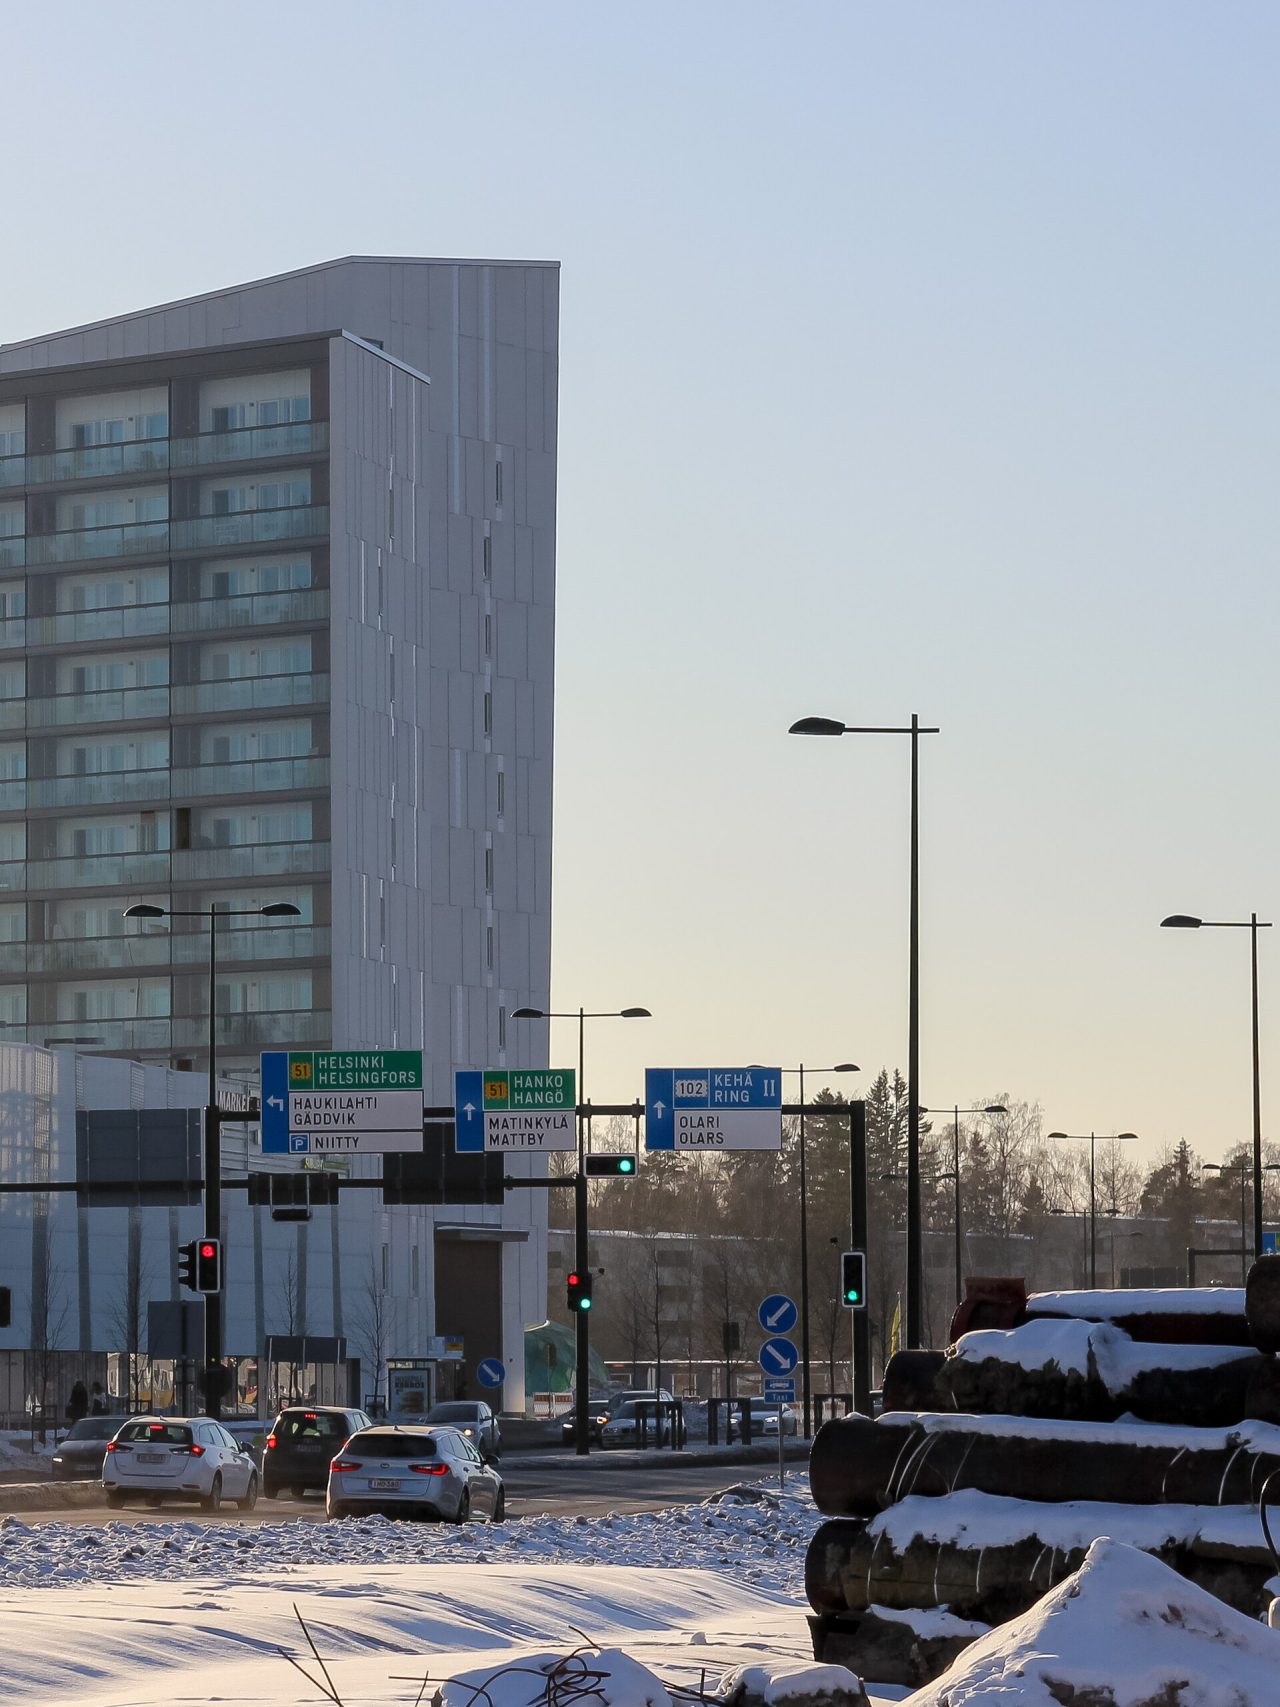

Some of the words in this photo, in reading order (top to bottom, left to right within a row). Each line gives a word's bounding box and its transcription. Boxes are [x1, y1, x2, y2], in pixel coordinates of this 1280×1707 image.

[319, 1056, 385, 1069] HELSINKI
[295, 1066, 308, 1077] 51
[319, 1071, 417, 1085] HELSINGFORS
[514, 1075, 564, 1088] HANKO
[714, 1072, 753, 1087] KEHÄ
[490, 1084, 503, 1096] 51
[679, 1082, 704, 1095] 102
[294, 1096, 378, 1110] HAUKILAHTI
[514, 1089, 564, 1104] HANGÖ
[714, 1090, 750, 1103] RING
[294, 1111, 356, 1126] GÄDDVIK
[489, 1114, 569, 1130] MATINKYLÄ
[679, 1115, 720, 1129] OLARI
[295, 1139, 304, 1150] P
[315, 1136, 360, 1149] NIITTY
[489, 1132, 545, 1146] MATTBY
[679, 1131, 724, 1145] OLARS
